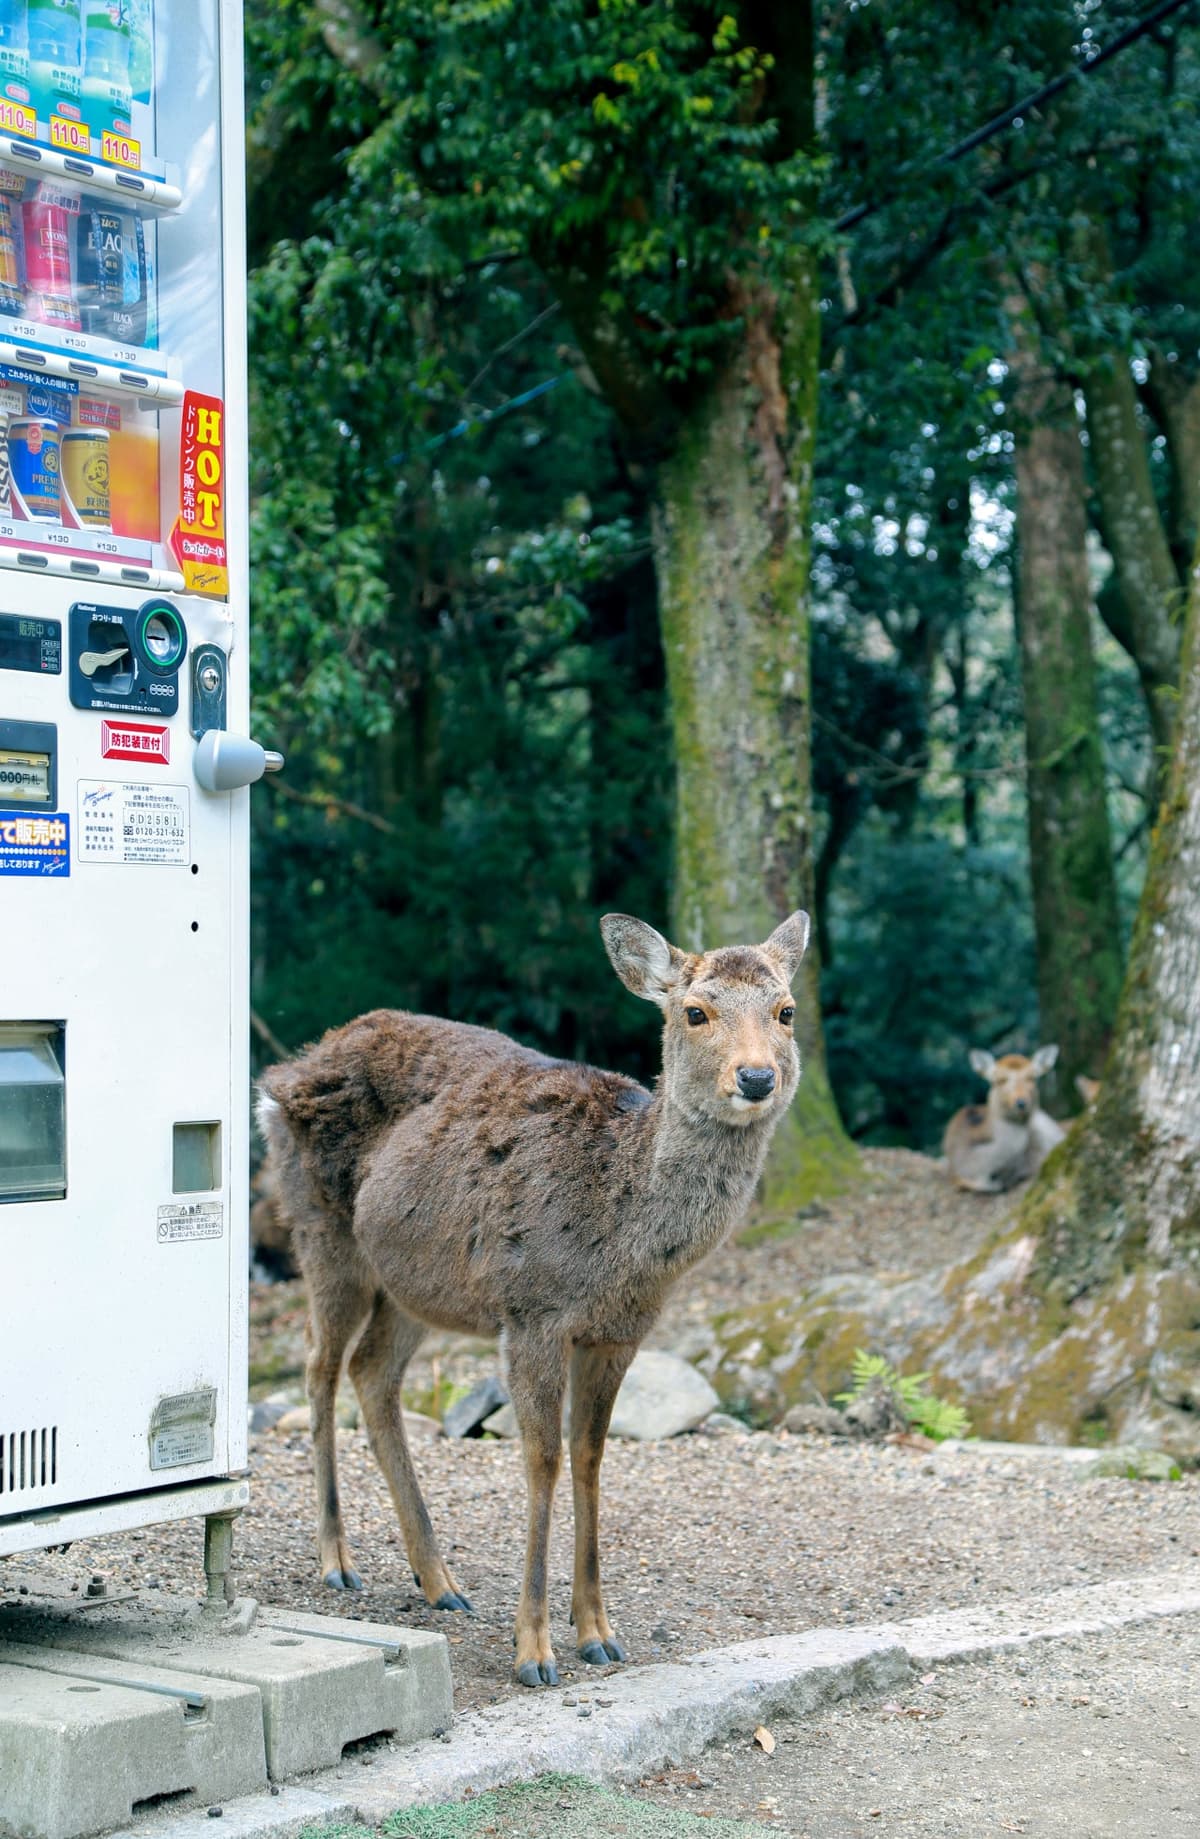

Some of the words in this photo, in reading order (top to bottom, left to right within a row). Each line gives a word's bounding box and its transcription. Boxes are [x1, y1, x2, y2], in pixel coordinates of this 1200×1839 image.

[53, 122, 88, 149] 110円
[105, 137, 138, 165] 110円
[13, 325, 36, 336] ¥130
[65, 338, 87, 348] ¥130
[183, 404, 196, 525] ドリンク販売中
[196, 408, 222, 528] HOT
[48, 534, 69, 544] ¥130
[97, 542, 118, 552] ¥130
[19, 620, 44, 637] 販売中
[111, 732, 161, 751] 防犯装置付
[0, 818, 66, 847] て販売中
[135, 828, 184, 837] 0120-521-632
